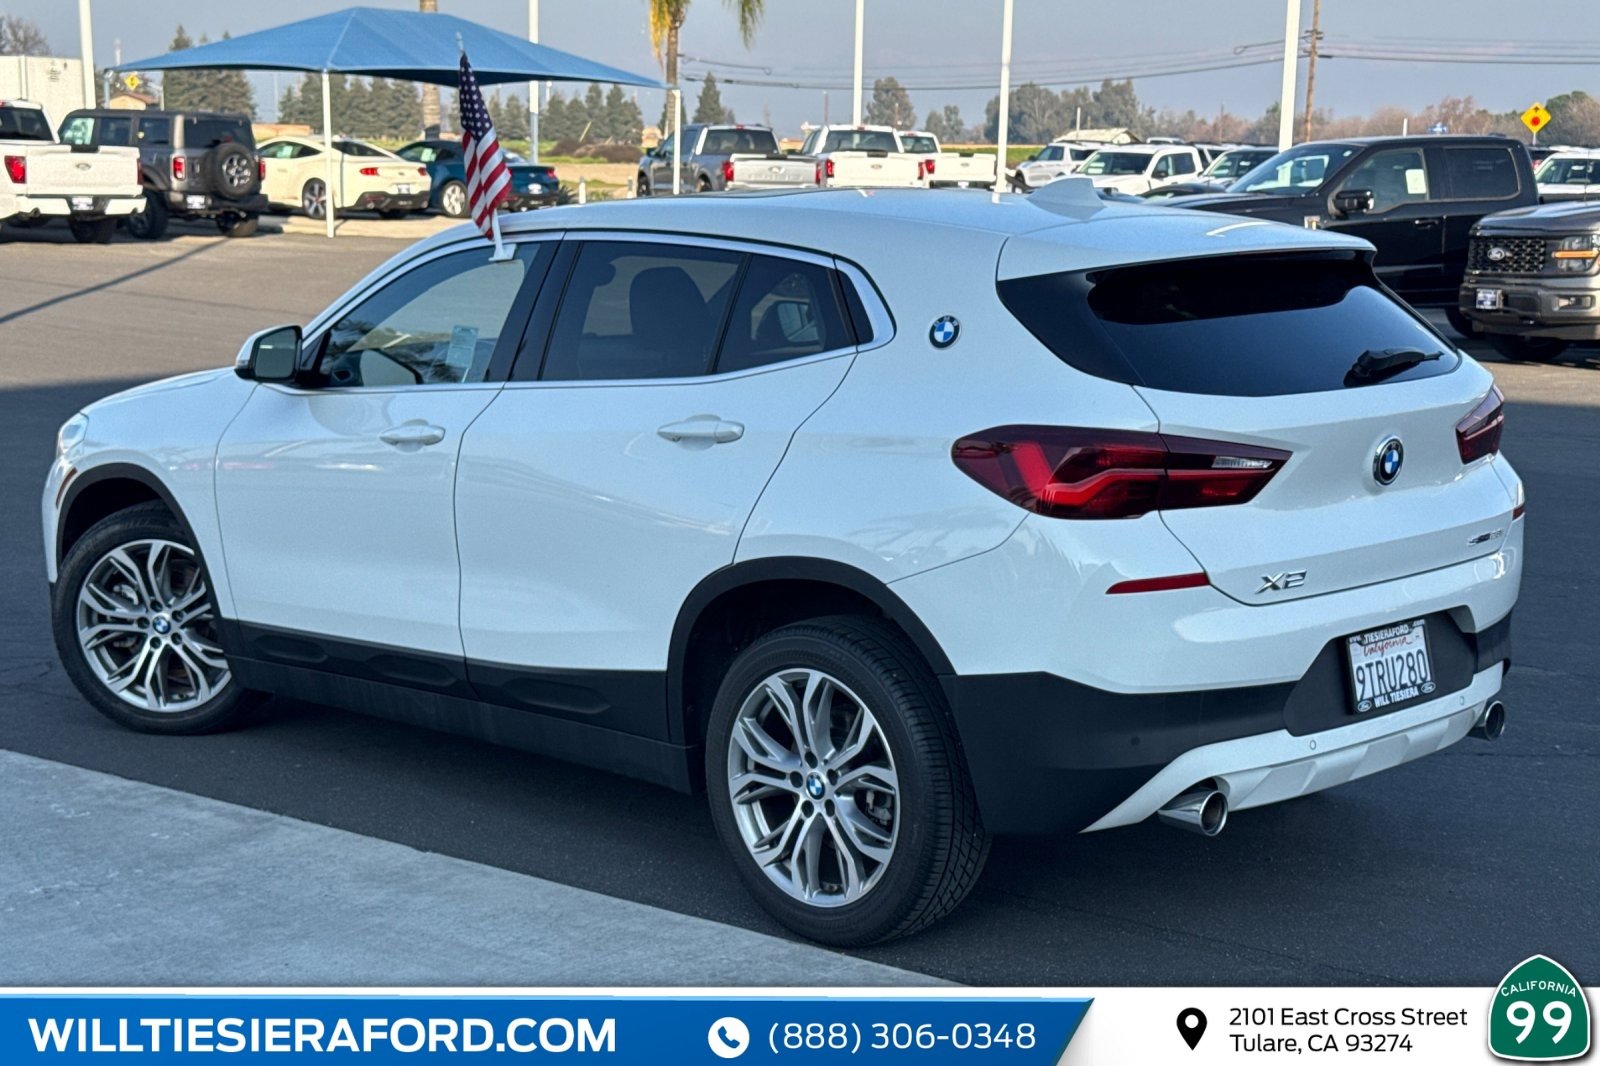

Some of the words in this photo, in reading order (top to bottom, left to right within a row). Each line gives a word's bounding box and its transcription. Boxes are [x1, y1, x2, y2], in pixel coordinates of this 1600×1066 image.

[1255, 569, 1307, 594] X2
[1363, 636, 1414, 657] California
[1356, 648, 1428, 701] 9TRU280
